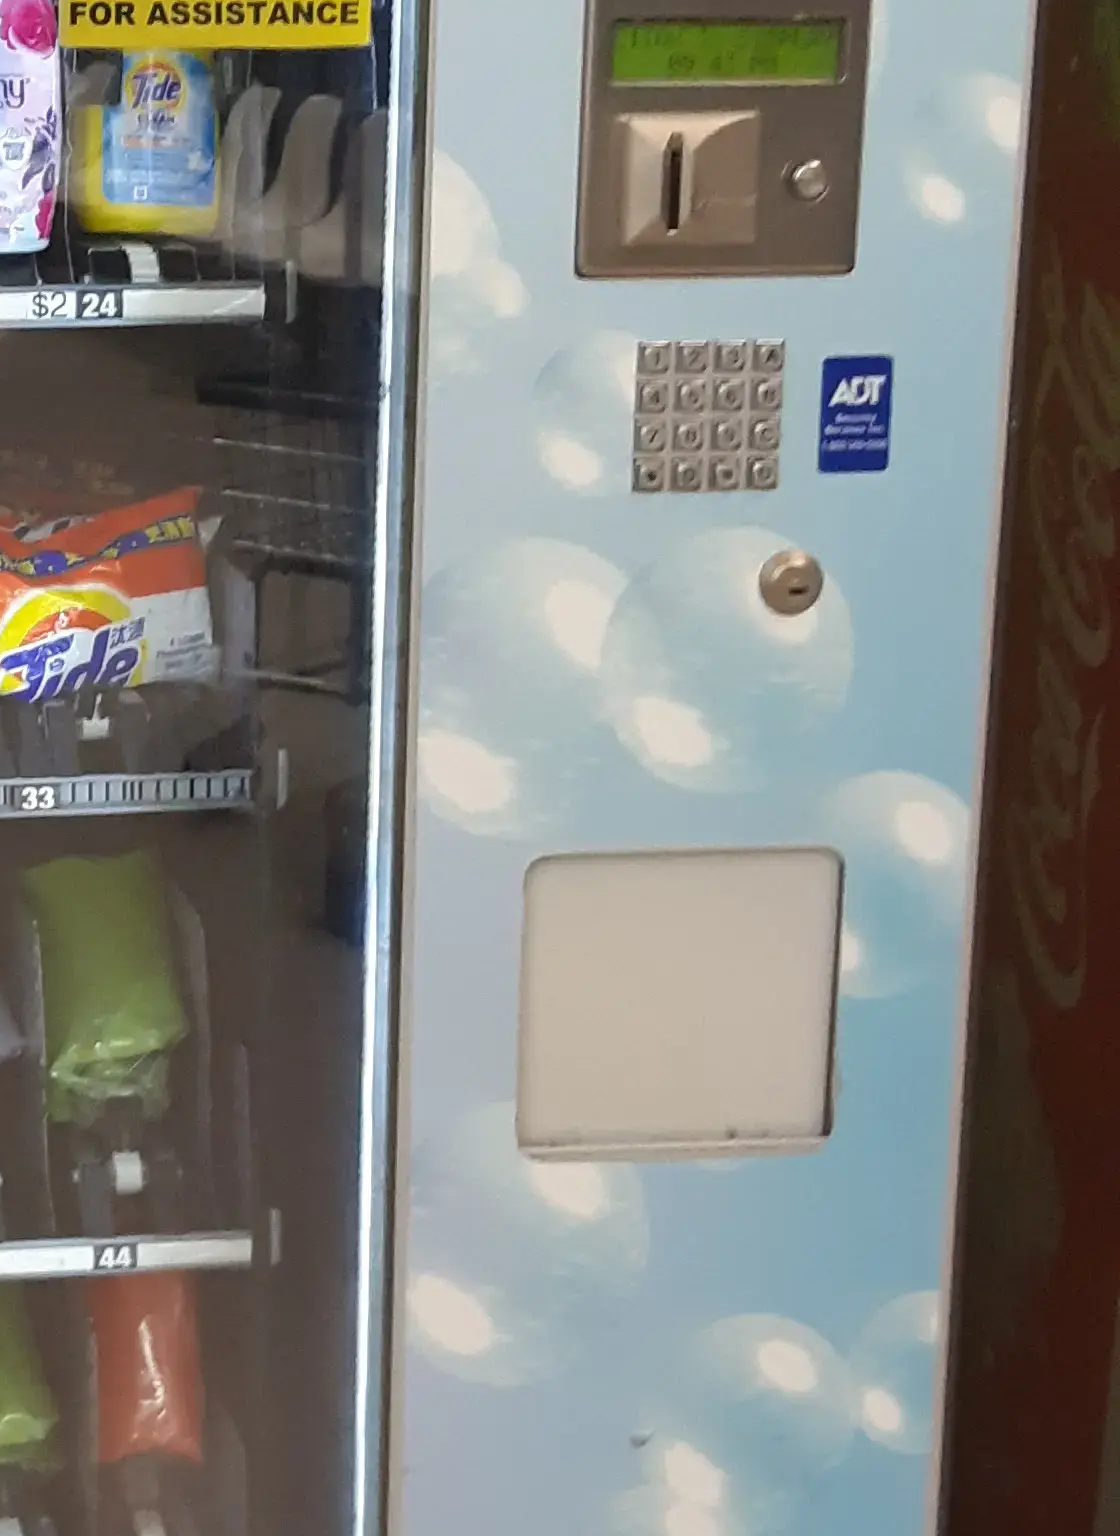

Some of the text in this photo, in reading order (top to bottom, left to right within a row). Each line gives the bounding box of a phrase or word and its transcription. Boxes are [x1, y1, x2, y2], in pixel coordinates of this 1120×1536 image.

[69, 0, 360, 27] FOR ASSISTANCE
[132, 74, 181, 109] Tide
[31, 291, 68, 318] $2
[82, 294, 117, 318] 24
[828, 375, 887, 408] ADT
[20, 786, 56, 810] 33
[98, 1245, 133, 1268] 44
